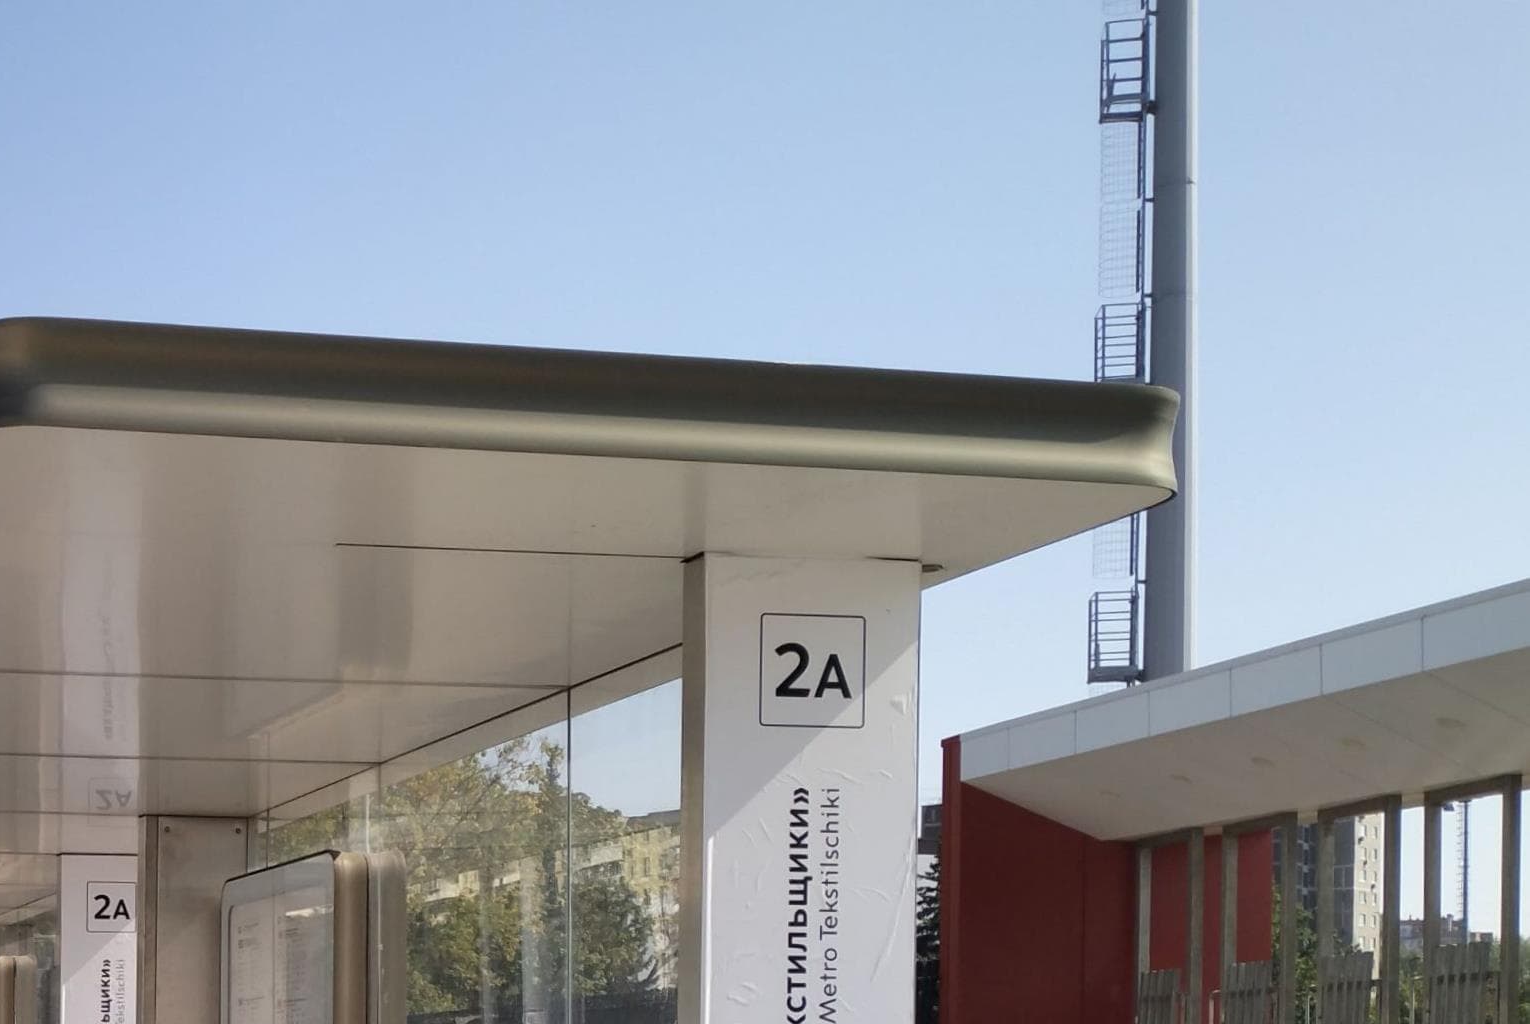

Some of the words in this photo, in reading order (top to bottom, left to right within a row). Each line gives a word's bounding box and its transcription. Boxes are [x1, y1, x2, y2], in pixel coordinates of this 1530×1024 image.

[774, 642, 852, 699] 2А
[818, 787, 841, 940] Tekstilschiki
[93, 894, 131, 920] 2А
[818, 947, 838, 1024] Metro
